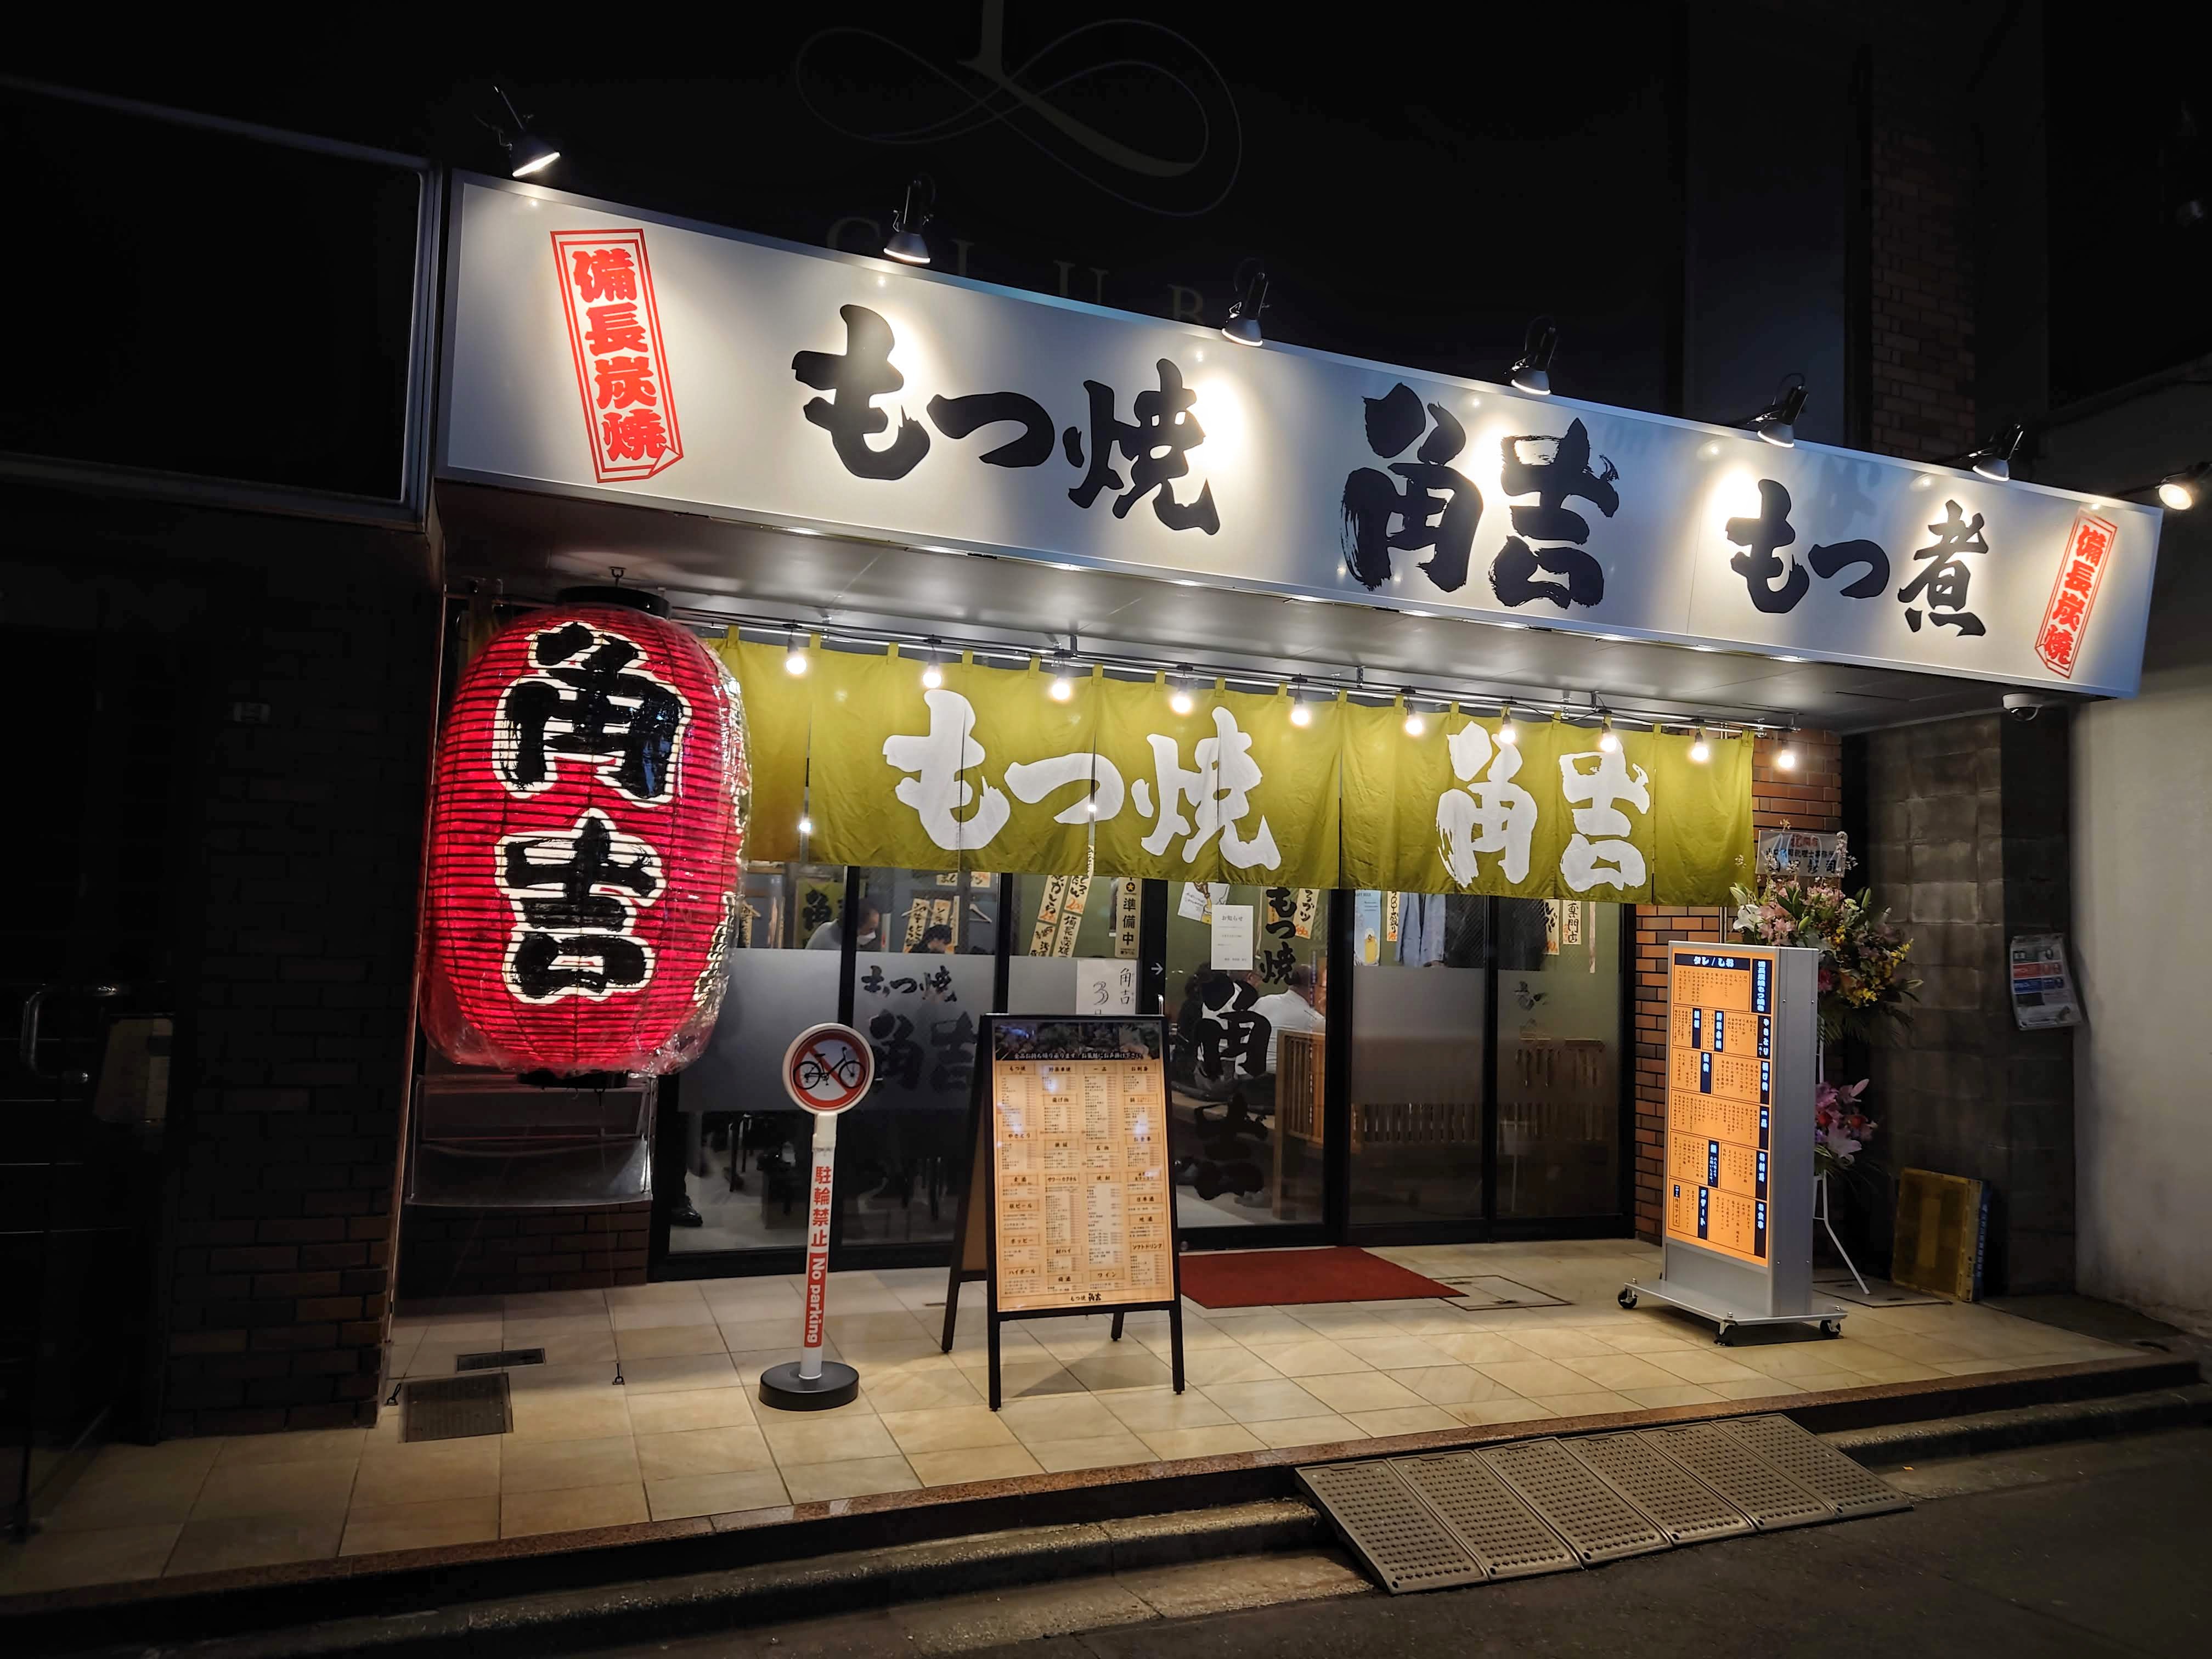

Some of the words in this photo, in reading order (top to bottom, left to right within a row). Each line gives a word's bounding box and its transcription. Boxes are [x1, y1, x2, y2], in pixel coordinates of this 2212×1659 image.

[792, 304, 1221, 535] もつ焼
[1341, 382, 1619, 609] 角吉
[1726, 479, 1989, 636] もつ煮
[493, 620, 692, 1004] 角吉
[883, 689, 1281, 871] もつ焼
[1436, 721, 1650, 891] 角吉
[1122, 898, 1136, 946] 準備中
[1260, 886, 1300, 986] もつ焼
[1120, 968, 1131, 1005] 角吉
[811, 1166, 832, 1247] 駐輪禁止
[811, 1258, 825, 1280] No
[808, 1284, 822, 1344] parking
